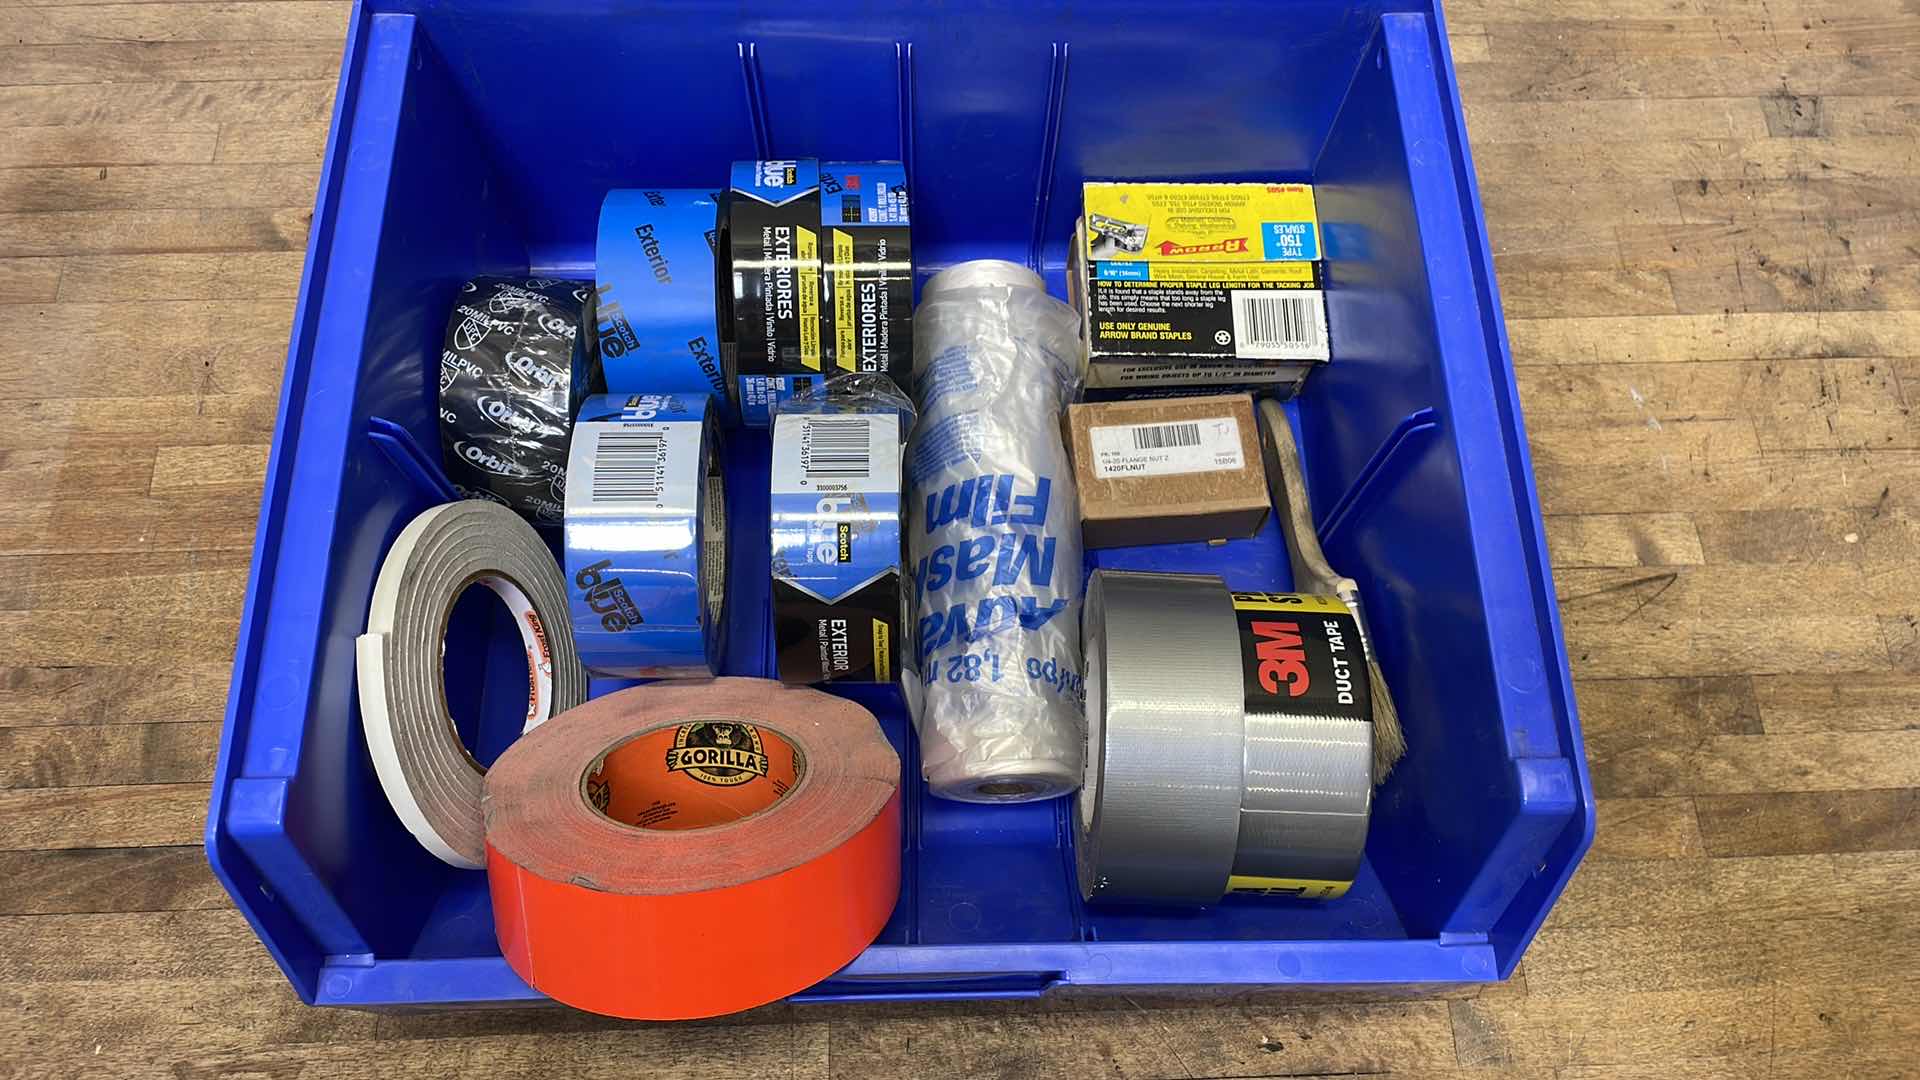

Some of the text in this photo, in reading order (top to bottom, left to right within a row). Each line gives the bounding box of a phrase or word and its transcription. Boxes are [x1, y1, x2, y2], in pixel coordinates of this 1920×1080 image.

[1273, 224, 1306, 234] STAPLES
[634, 223, 673, 285] Exterior
[877, 238, 887, 261] Vidrio
[1282, 249, 1303, 257] TYPE
[774, 226, 793, 320] EXTERIORES
[762, 226, 777, 362] Metal Maera Pintada Vinilo Vidrio
[878, 291, 888, 321] Pintada
[861, 283, 877, 373] EXTERIORES
[878, 321, 889, 350] Madera
[1099, 322, 1171, 331] USE ONLY GENUINE
[1099, 331, 1192, 340] ARROW BRAND STAPLES
[879, 354, 889, 373] Metal
[801, 425, 812, 444] 51141
[465, 446, 515, 476] Orbit
[657, 439, 668, 463] 36197
[800, 446, 811, 470] 36197
[1121, 456, 1148, 464] FLANGE
[655, 466, 666, 492] 51141
[1104, 463, 1146, 472] 1420FLNUT
[926, 474, 1052, 535] Film
[839, 525, 849, 562] Scotch
[576, 559, 632, 632] blue
[612, 588, 641, 624] Scotch
[818, 619, 828, 637] Metal
[831, 619, 849, 672] EXTERIOR
[1251, 620, 1311, 698] 3M
[947, 650, 1004, 684] 1,82
[1323, 619, 1354, 705] DUCT TAPE
[680, 748, 758, 770] GORILLA
